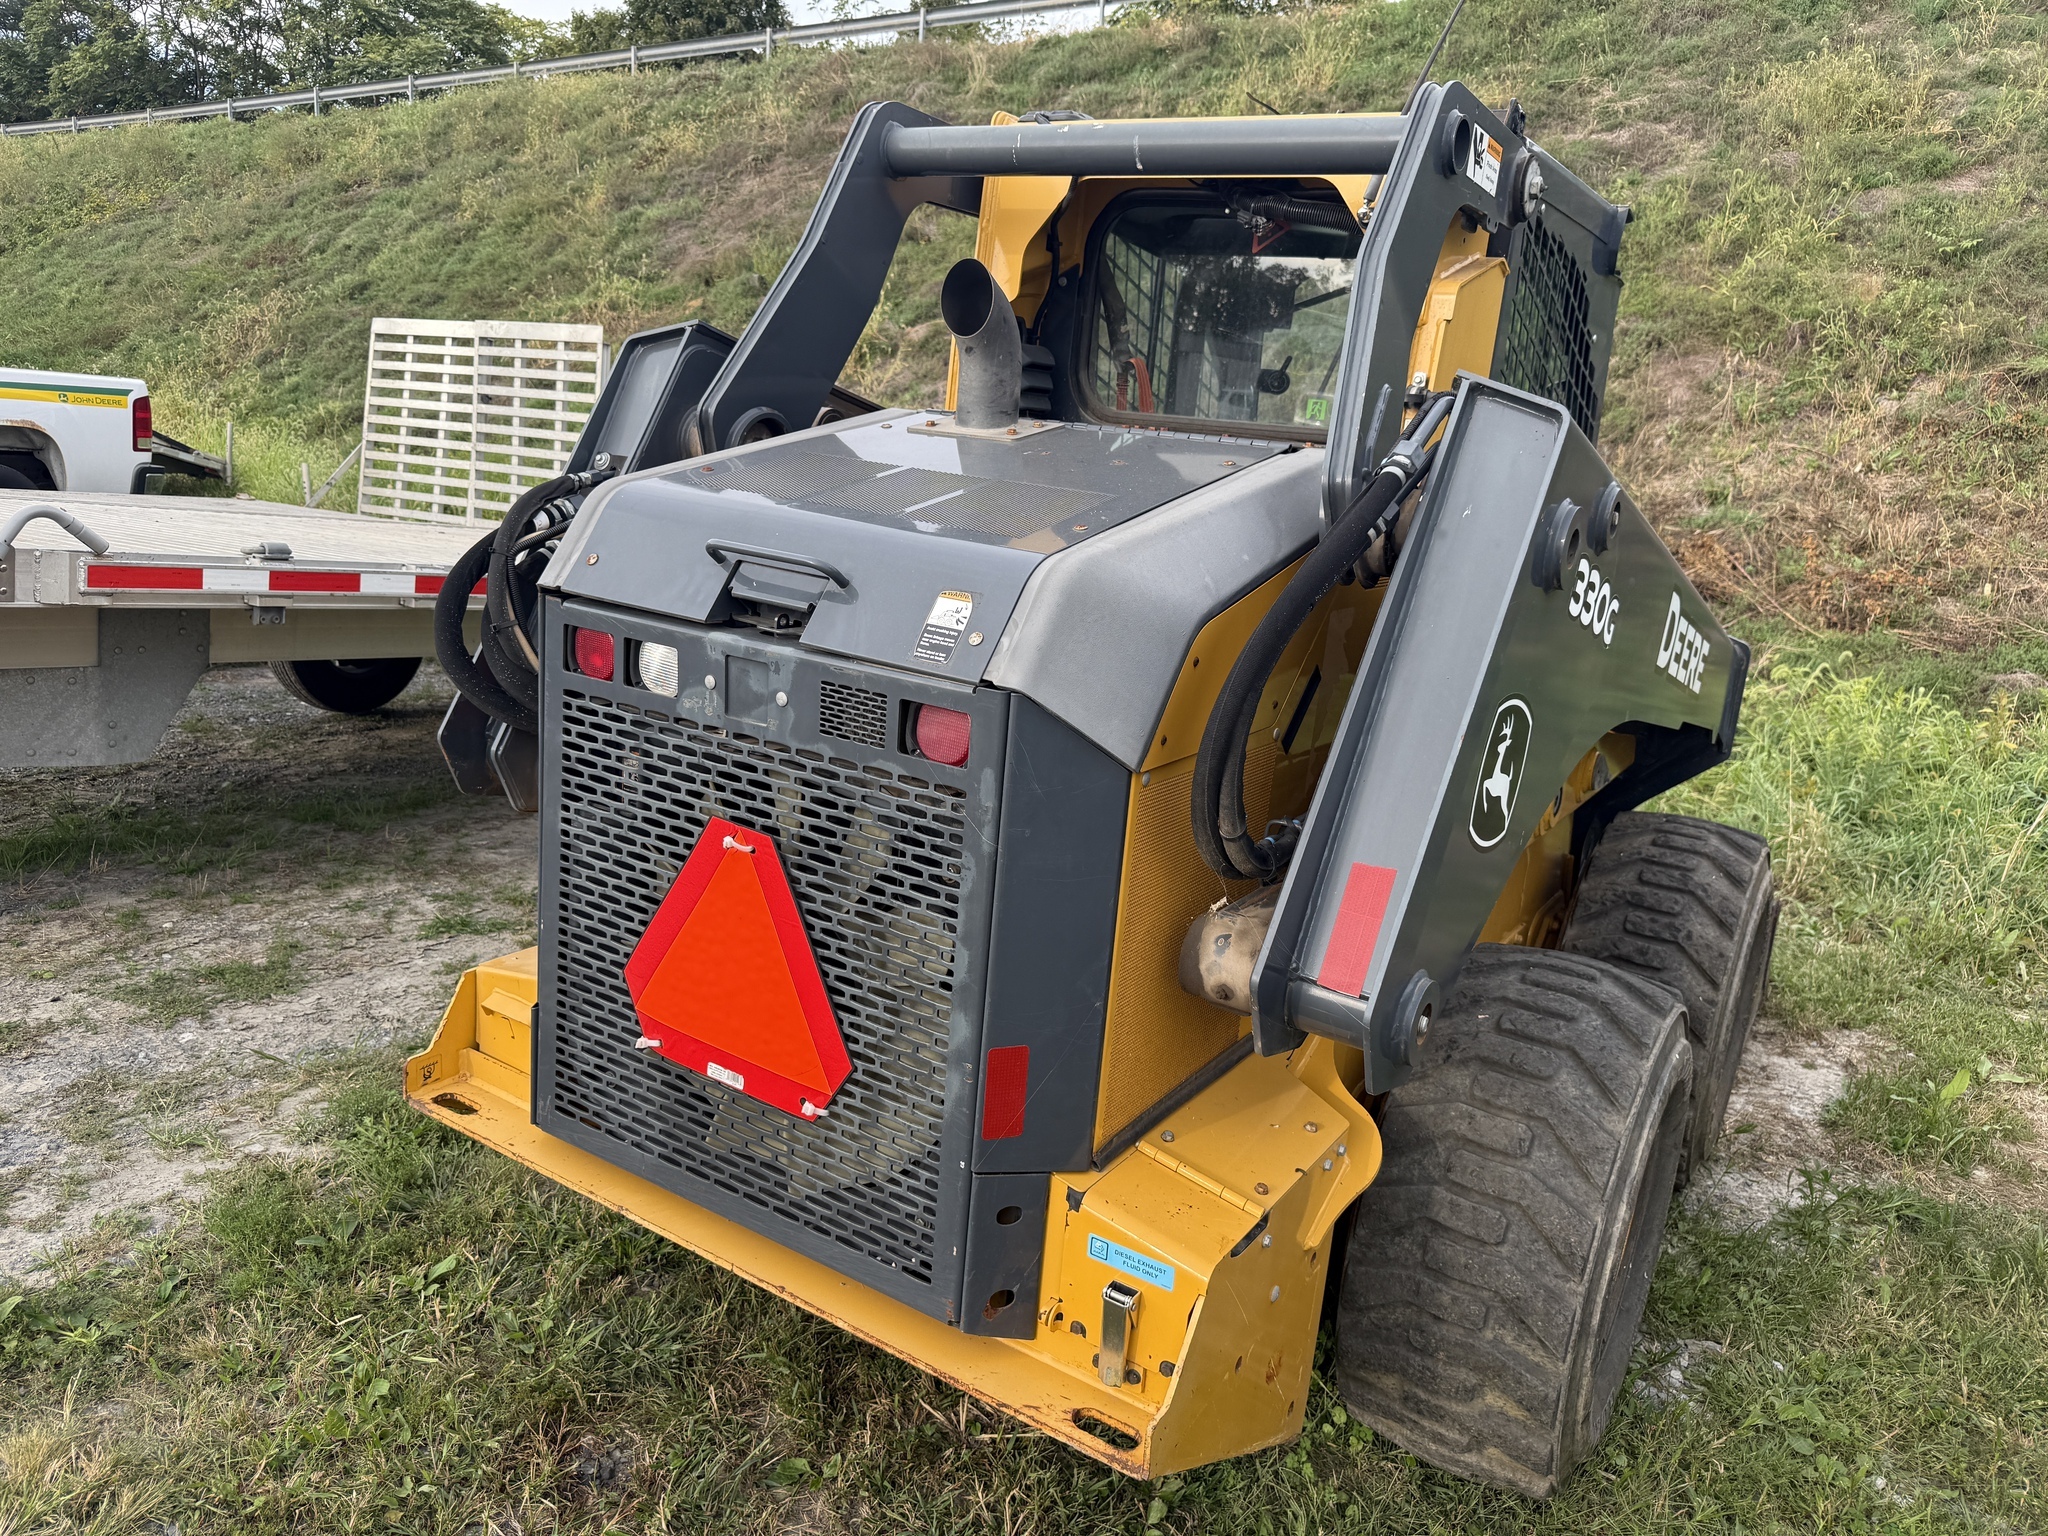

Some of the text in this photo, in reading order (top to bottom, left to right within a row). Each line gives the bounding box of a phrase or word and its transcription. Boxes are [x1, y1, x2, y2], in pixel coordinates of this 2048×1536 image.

[72, 395, 122, 406] JOHN DEERE
[1569, 558, 1620, 645] 330G
[1656, 591, 1710, 694] DEERE
[1114, 1249, 1136, 1262] DIESEL
[1138, 1259, 1167, 1276] EXHAUST
[1122, 1260, 1159, 1279] FLUID ONLY
